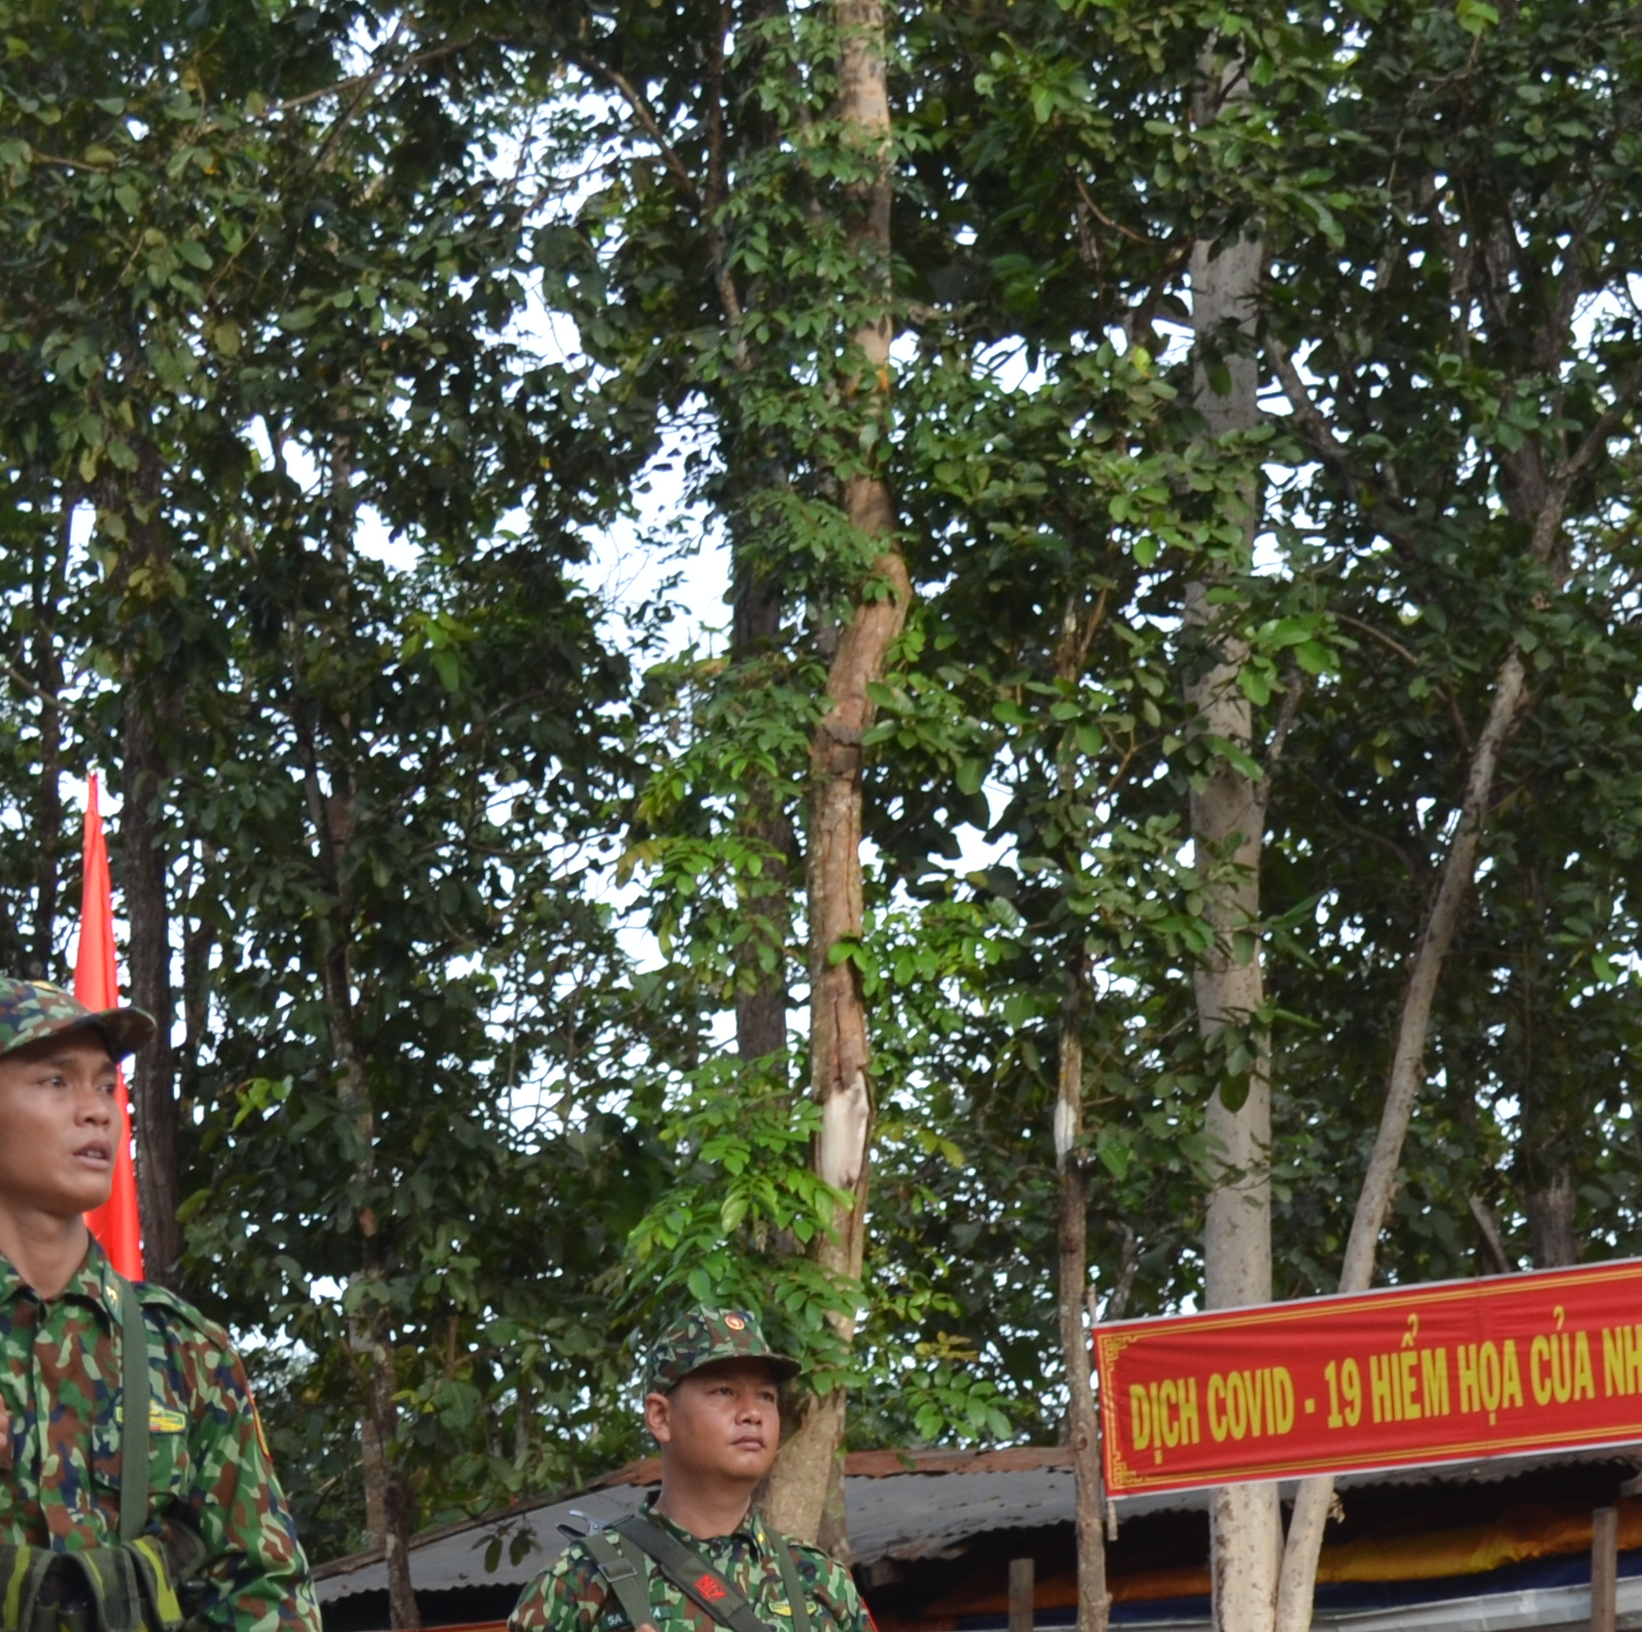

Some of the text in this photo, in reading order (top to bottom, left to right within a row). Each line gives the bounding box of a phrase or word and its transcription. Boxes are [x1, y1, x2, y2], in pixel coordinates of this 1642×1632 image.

[1130, 1377, 1201, 1465] DỊCH
[1208, 1365, 1294, 1443] COVID
[1305, 1399, 1315, 1413] -
[1325, 1358, 1362, 1428] 19
[1370, 1313, 1450, 1423] HIỂM
[1458, 1339, 1523, 1425] HỌA
[1530, 1305, 1596, 1405] CỦA
